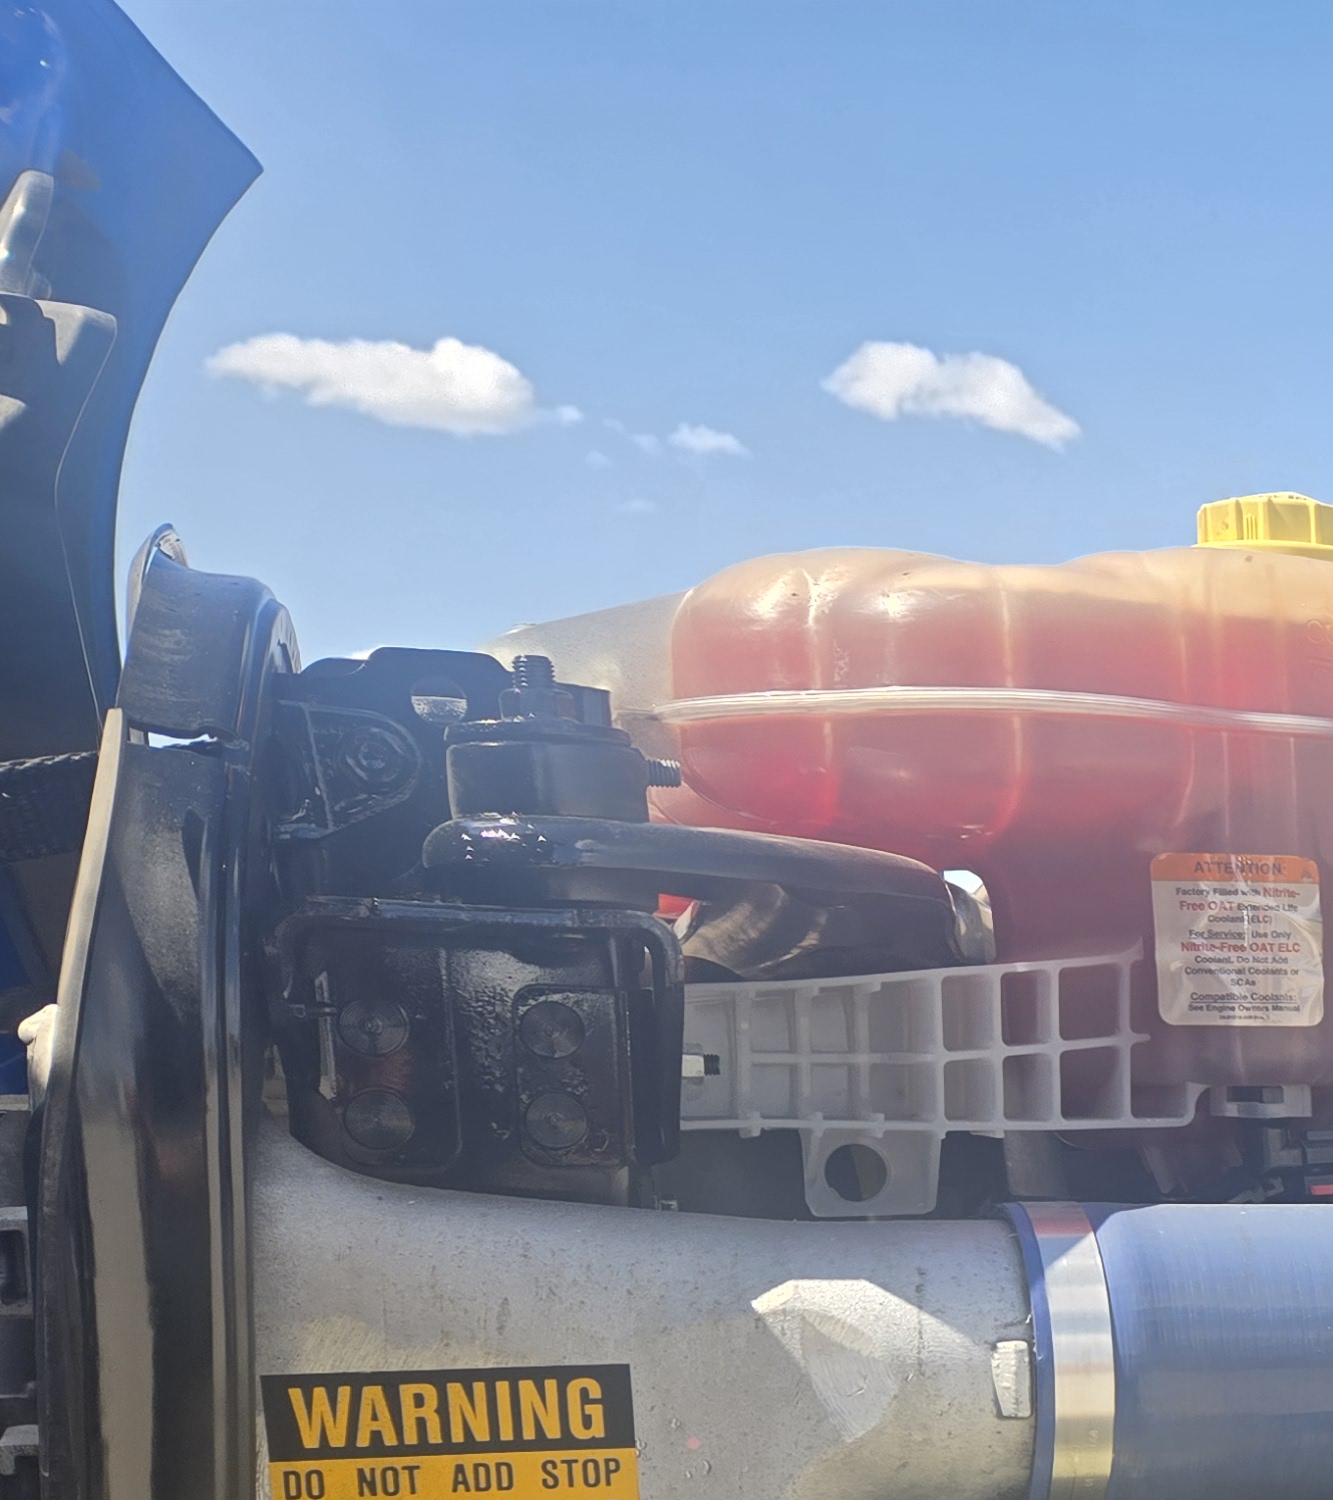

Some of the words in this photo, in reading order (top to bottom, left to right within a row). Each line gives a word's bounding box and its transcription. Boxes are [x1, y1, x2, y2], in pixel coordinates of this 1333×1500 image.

[1193, 861, 1283, 875] ATTENTION
[1176, 887, 1210, 898] Factory
[1213, 888, 1238, 897] Filled
[1263, 887, 1300, 898] Nitrite-
[1179, 901, 1205, 911] Free
[1208, 901, 1235, 911] OAT
[1249, 915, 1273, 925] (ELC)
[1188, 929, 1206, 939] For
[1207, 929, 1247, 939] Service:
[1251, 931, 1268, 939] Use
[1271, 931, 1291, 941] Only
[1181, 942, 1247, 953] Nitrite-Free
[1249, 942, 1275, 953] OAT
[1278, 943, 1300, 953] ELC
[1236, 956, 1249, 964] Do
[1251, 956, 1269, 964] Not
[1271, 956, 1288, 964] Add
[1184, 966, 1246, 976] Conventional
[1248, 966, 1288, 976] Coolants
[1230, 978, 1257, 987] SCAs
[1190, 992, 1248, 1002] Compatible
[1250, 992, 1297, 1002] Coolants:
[1188, 1004, 1204, 1012] See
[1206, 1004, 1235, 1014] Engine
[1237, 1004, 1269, 1012] Owners
[1271, 1004, 1300, 1012] Manual
[287, 1376, 605, 1450] WARNING
[282, 1468, 325, 1500] DO
[356, 1465, 422, 1498] NOT
[451, 1461, 515, 1494] ADD
[541, 1457, 621, 1490] STOP
